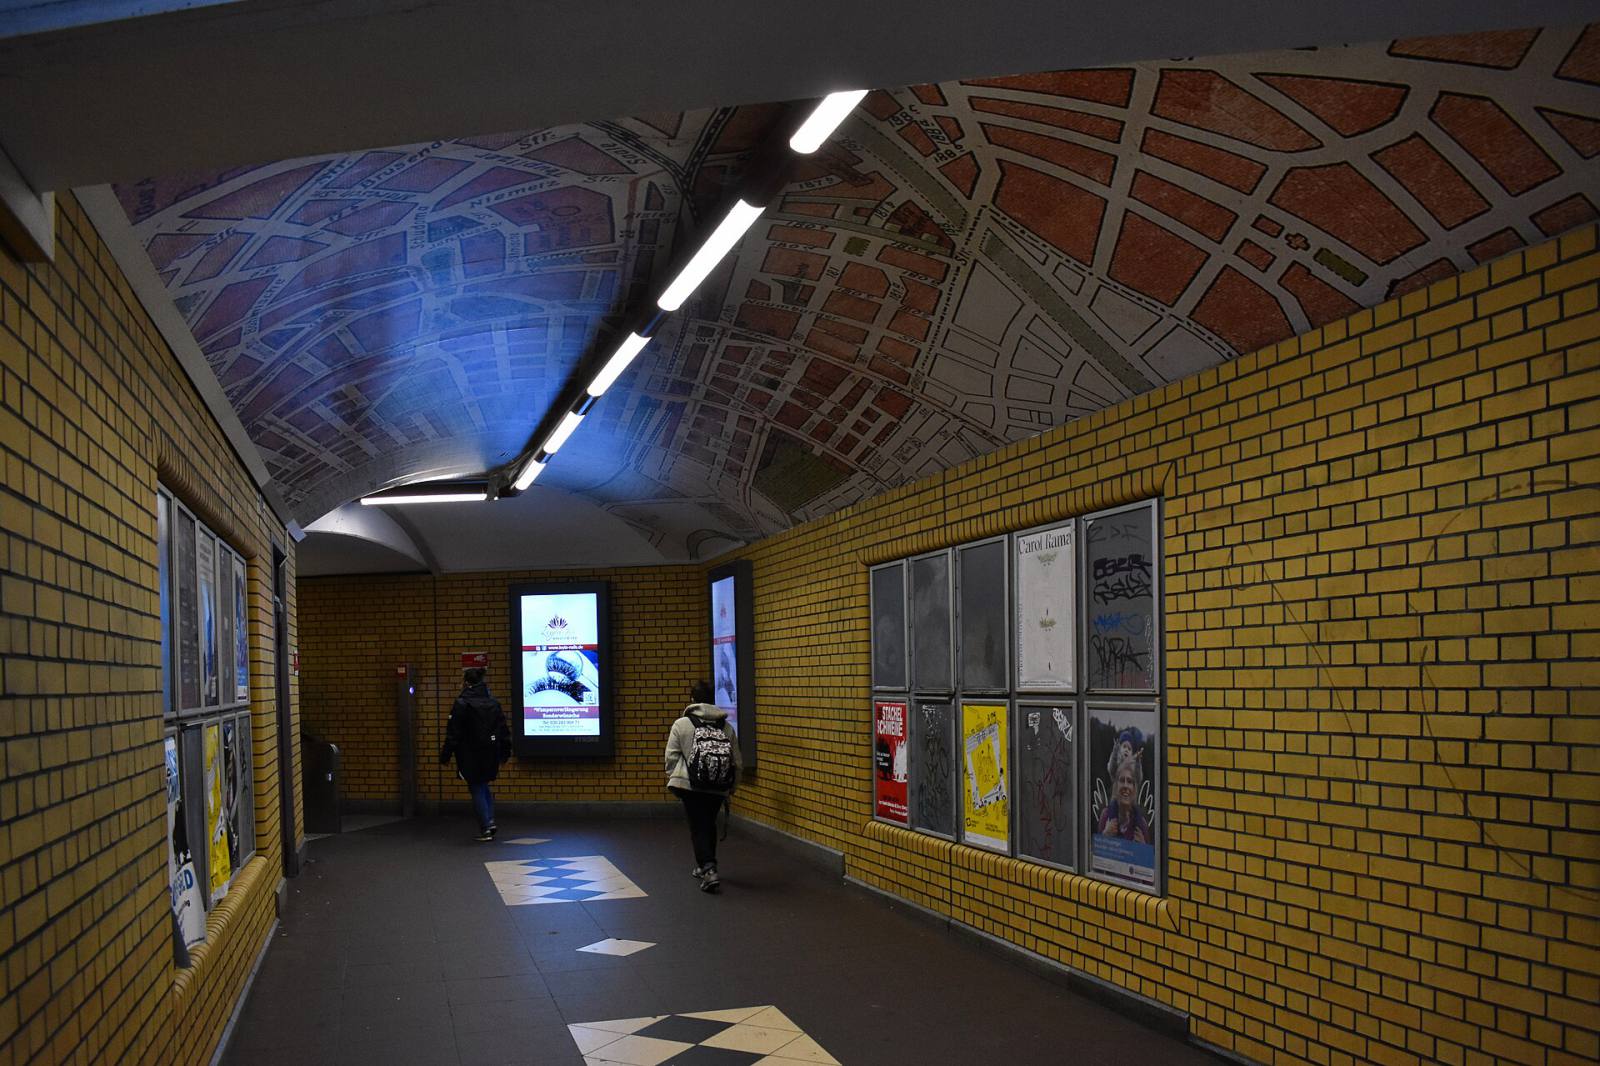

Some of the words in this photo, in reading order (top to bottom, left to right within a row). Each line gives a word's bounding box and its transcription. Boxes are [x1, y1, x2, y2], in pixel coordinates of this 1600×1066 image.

[1018, 536, 1042, 554] Carol
[1045, 532, 1072, 549] Rama
[882, 705, 903, 722] STACHEL
[877, 719, 903, 737] SCHWEINE
